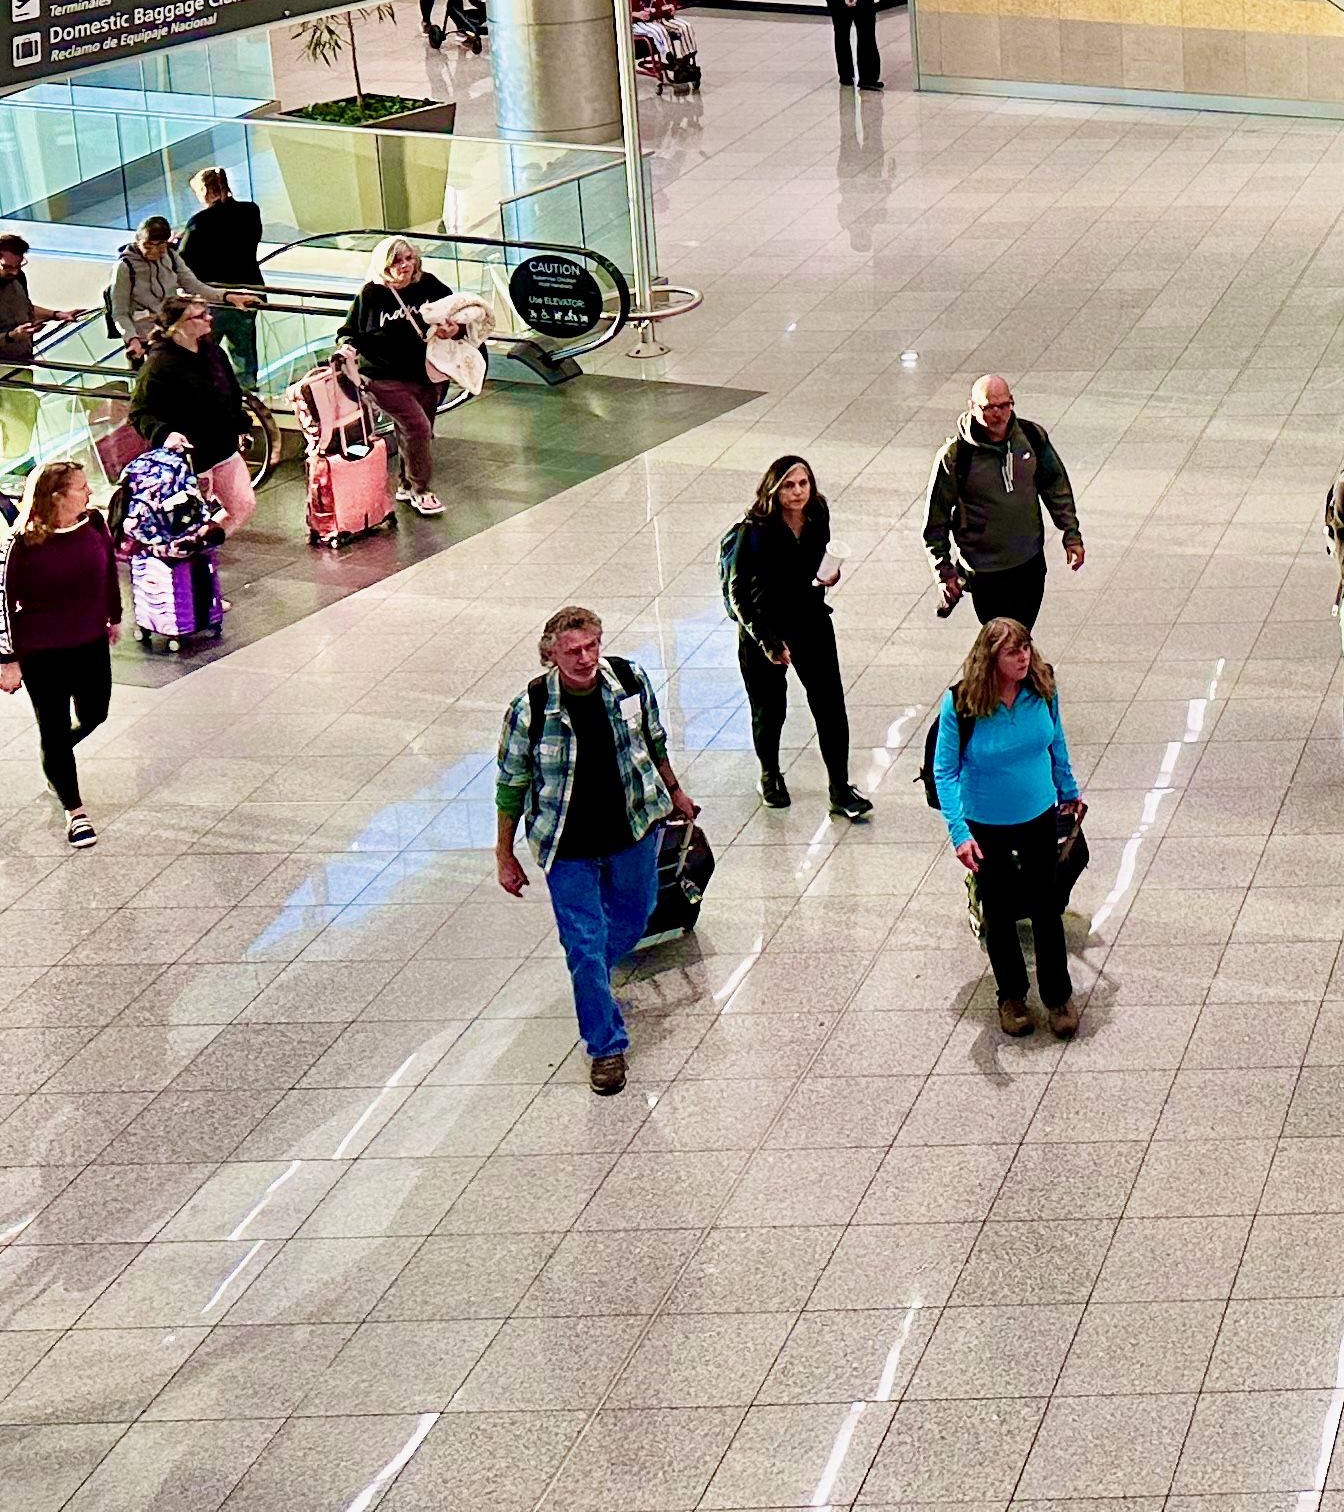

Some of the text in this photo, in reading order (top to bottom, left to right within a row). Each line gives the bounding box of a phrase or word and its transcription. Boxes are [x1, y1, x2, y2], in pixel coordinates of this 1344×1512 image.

[49, 12, 130, 44] Domestic
[50, 12, 218, 63] Reclamo de Equipaje Nacional
[528, 260, 581, 276] CAUTION
[528, 295, 543, 304] Use
